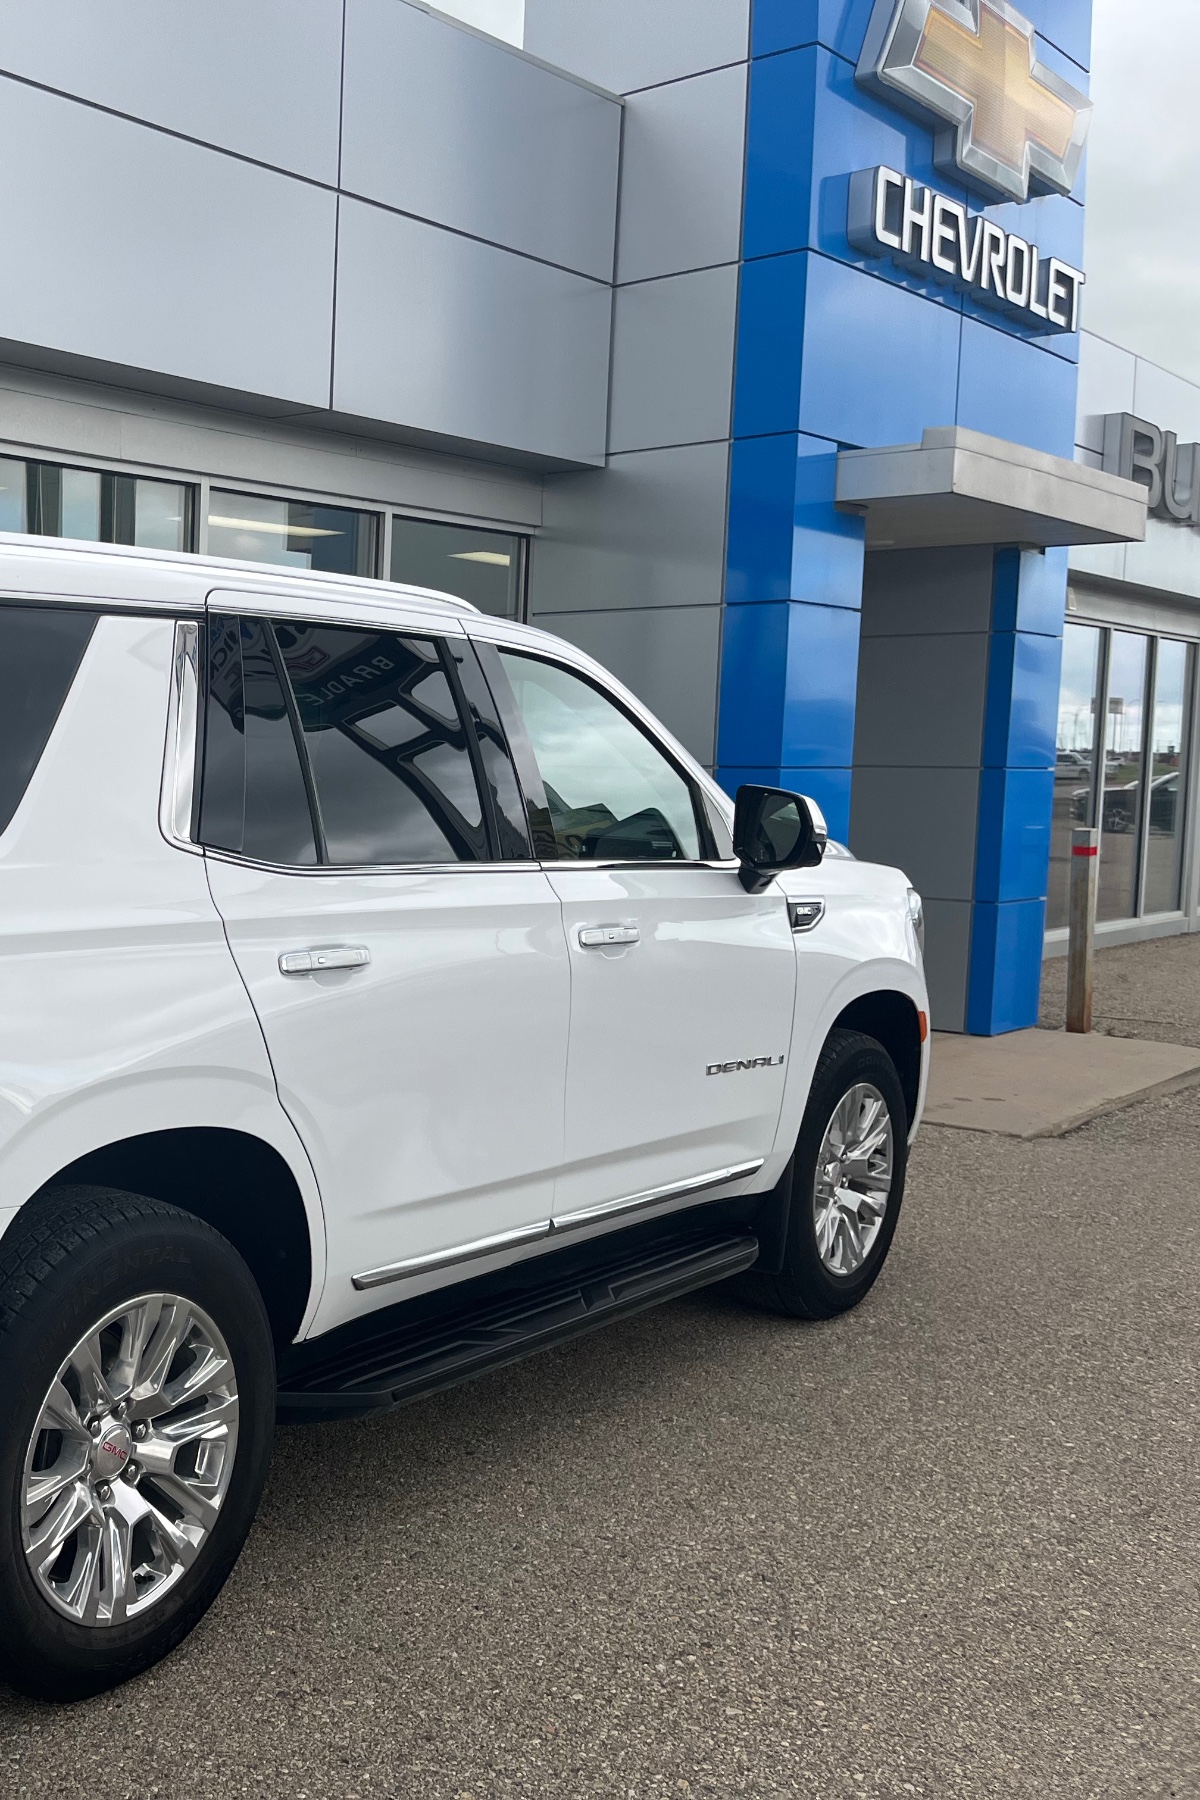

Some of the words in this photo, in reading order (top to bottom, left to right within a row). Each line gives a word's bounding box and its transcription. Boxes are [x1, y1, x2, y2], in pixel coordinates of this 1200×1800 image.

[871, 165, 1086, 333] CHEVROLET
[705, 1054, 785, 1077] DENALI
[102, 1441, 128, 1462] GMC
